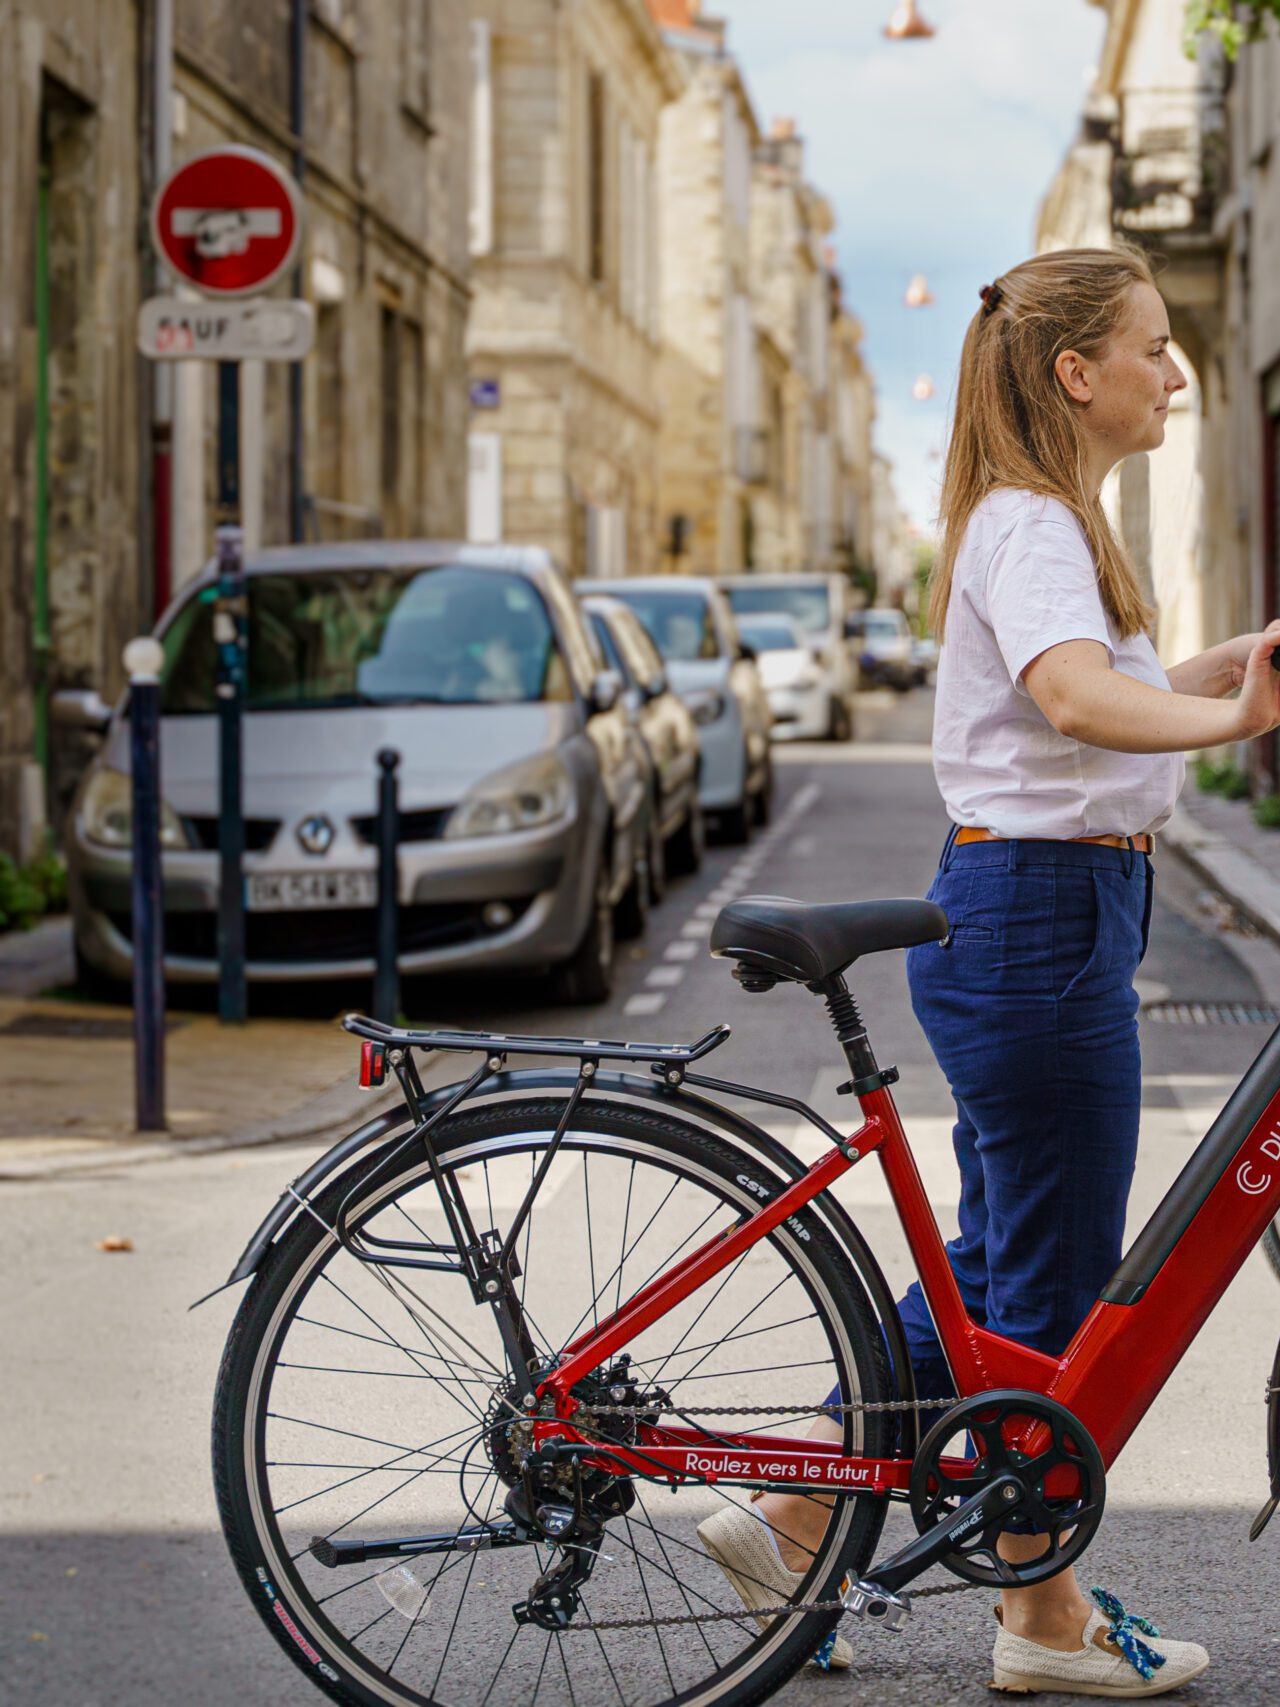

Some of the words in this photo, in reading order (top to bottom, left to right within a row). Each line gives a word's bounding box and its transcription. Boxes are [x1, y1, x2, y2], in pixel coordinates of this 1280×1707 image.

[736, 1174, 770, 1198] CST
[685, 1453, 751, 1474] Roulez
[757, 1464, 797, 1477] vers
[803, 1460, 821, 1478] le
[826, 1463, 869, 1481] futur
